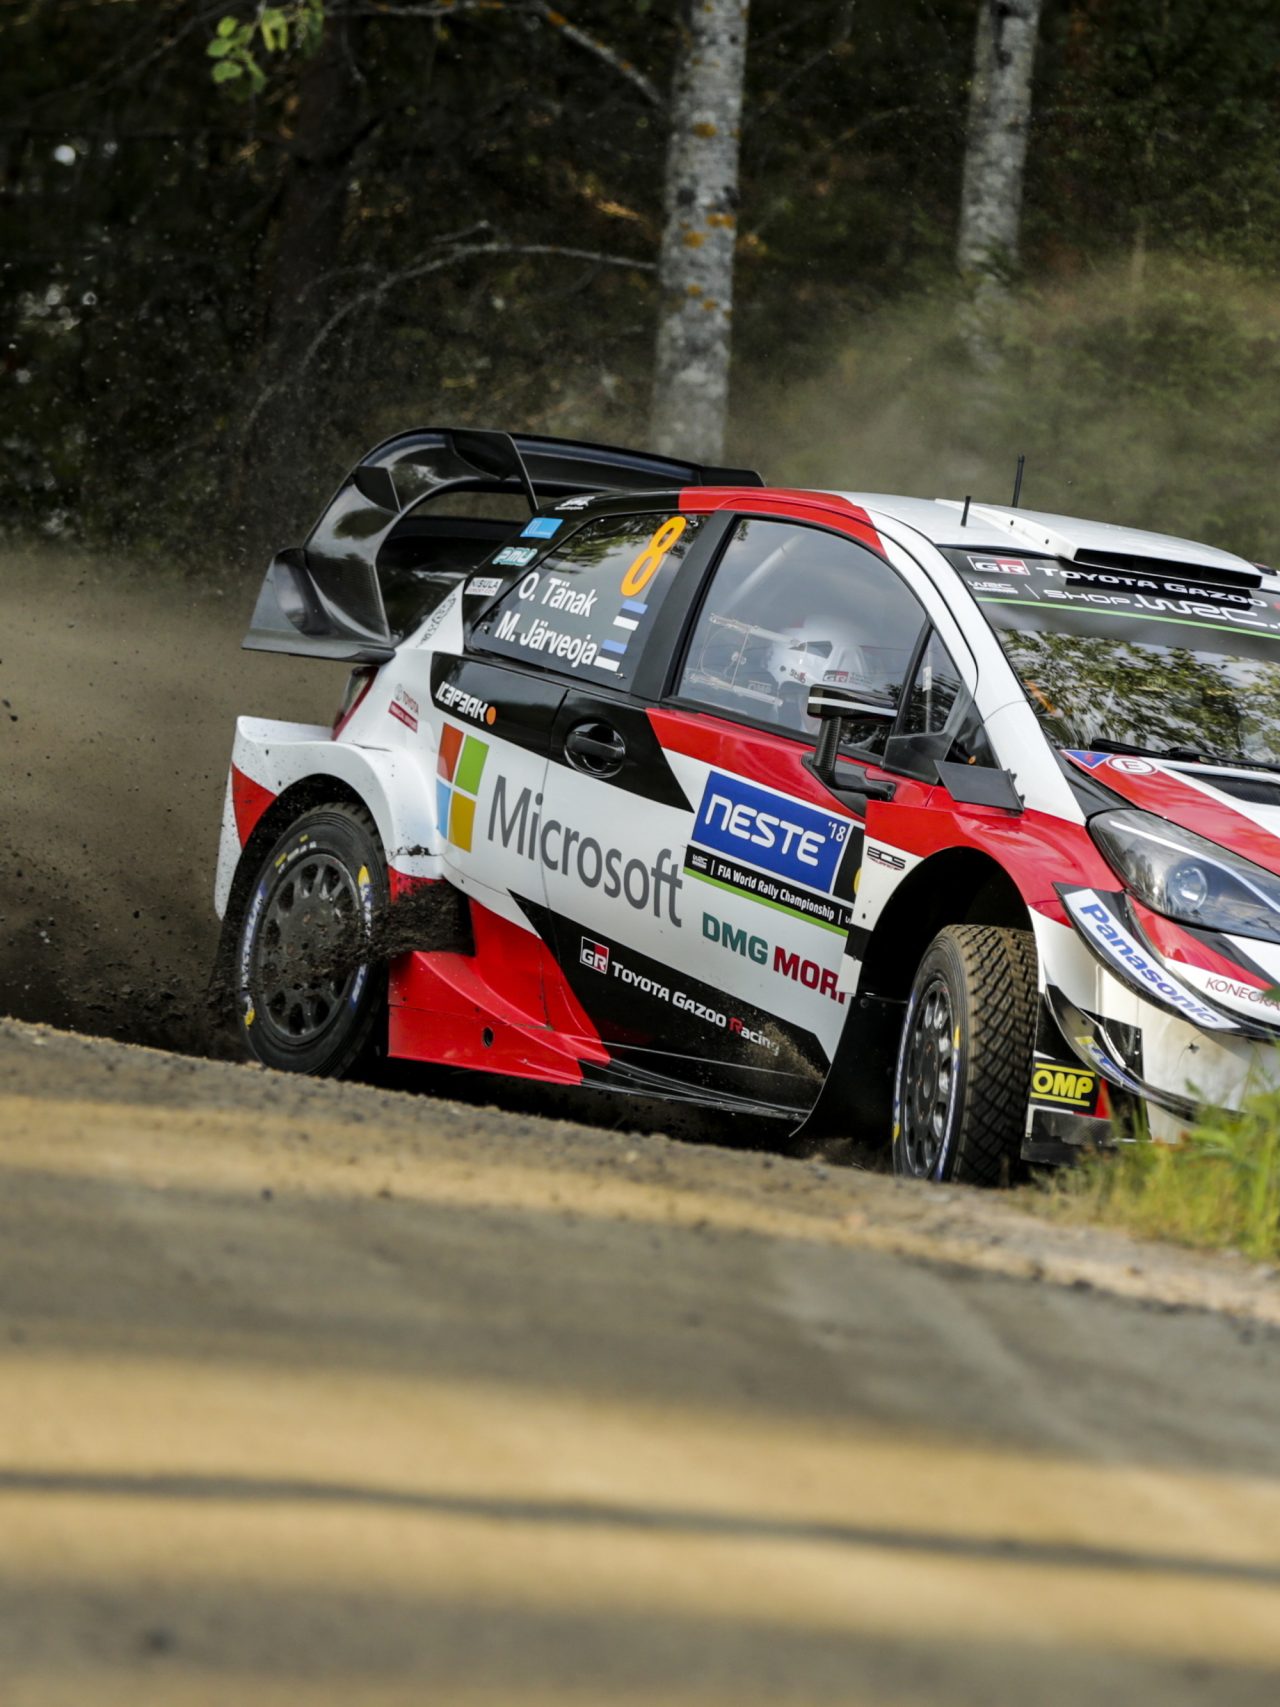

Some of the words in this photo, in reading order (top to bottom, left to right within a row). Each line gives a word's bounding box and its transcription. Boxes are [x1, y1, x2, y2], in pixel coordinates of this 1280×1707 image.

[620, 516, 687, 597] 8
[517, 571, 540, 601] O.
[541, 577, 598, 618] Tänak
[1035, 566, 1158, 590] TOYOTA
[1163, 582, 1268, 608] GAZOO
[494, 610, 521, 643] M.
[520, 618, 598, 669] Järveoja
[487, 774, 684, 929] Microsoft
[704, 793, 826, 867] NESTE
[717, 864, 732, 879] FIA
[732, 869, 757, 889] World
[757, 880, 779, 900] Rally
[779, 889, 835, 921] Championship
[702, 911, 769, 966] DMG
[1080, 903, 1219, 1026] Panasonic
[581, 949, 608, 972] GR
[611, 961, 670, 1002] TOYOTA
[672, 991, 727, 1029] GAZOO
[1032, 1069, 1094, 1100] OMP
